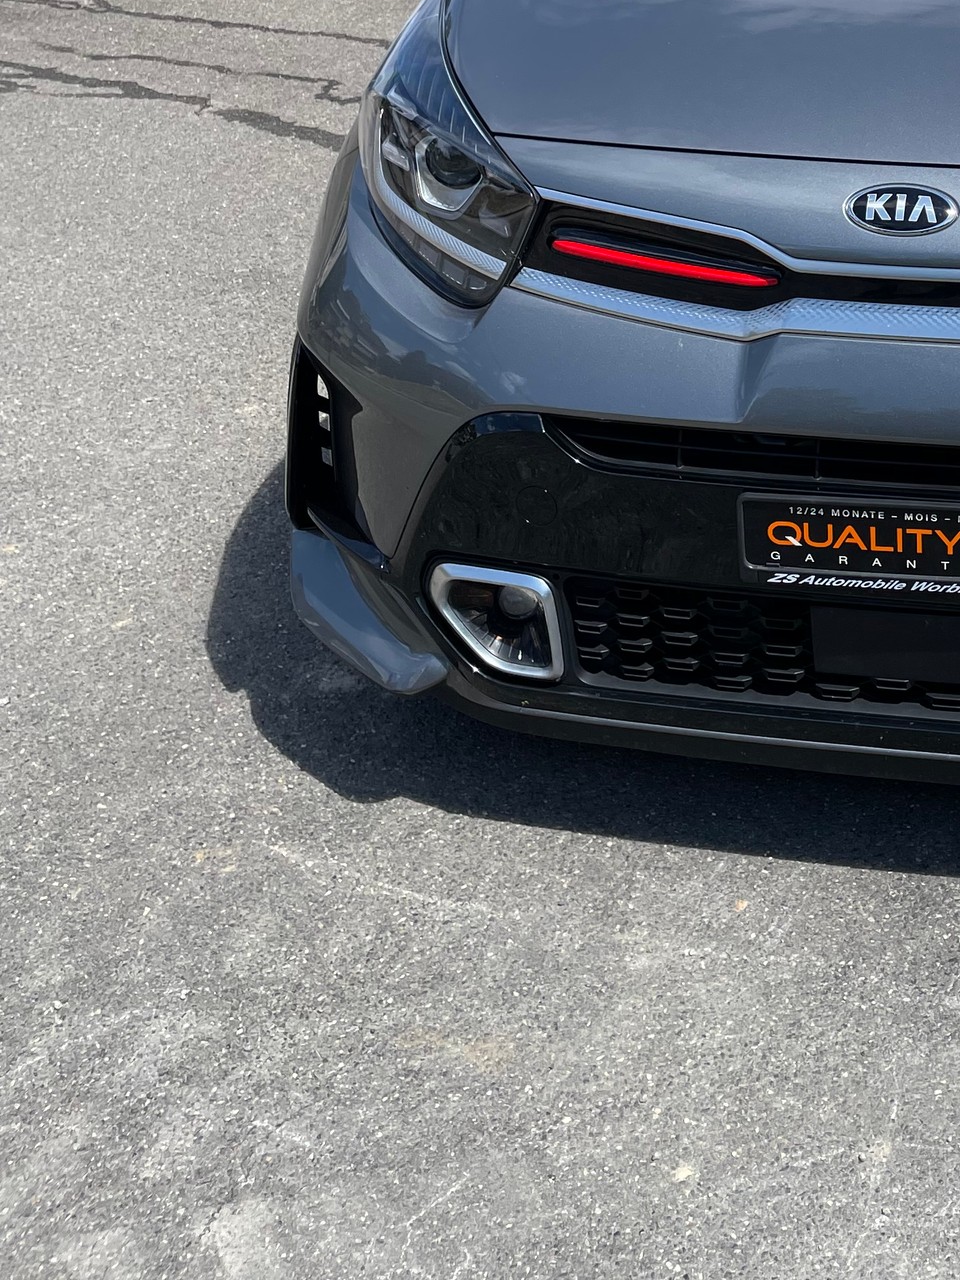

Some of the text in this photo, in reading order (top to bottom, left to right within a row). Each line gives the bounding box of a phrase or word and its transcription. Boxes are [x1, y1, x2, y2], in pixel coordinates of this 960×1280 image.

[865, 193, 937, 223] KIA
[789, 506, 825, 516] 12/24
[831, 508, 885, 520] MONATE
[904, 512, 938, 522] MOIS
[767, 573, 800, 584] ZS
[798, 575, 907, 591] Automobile
